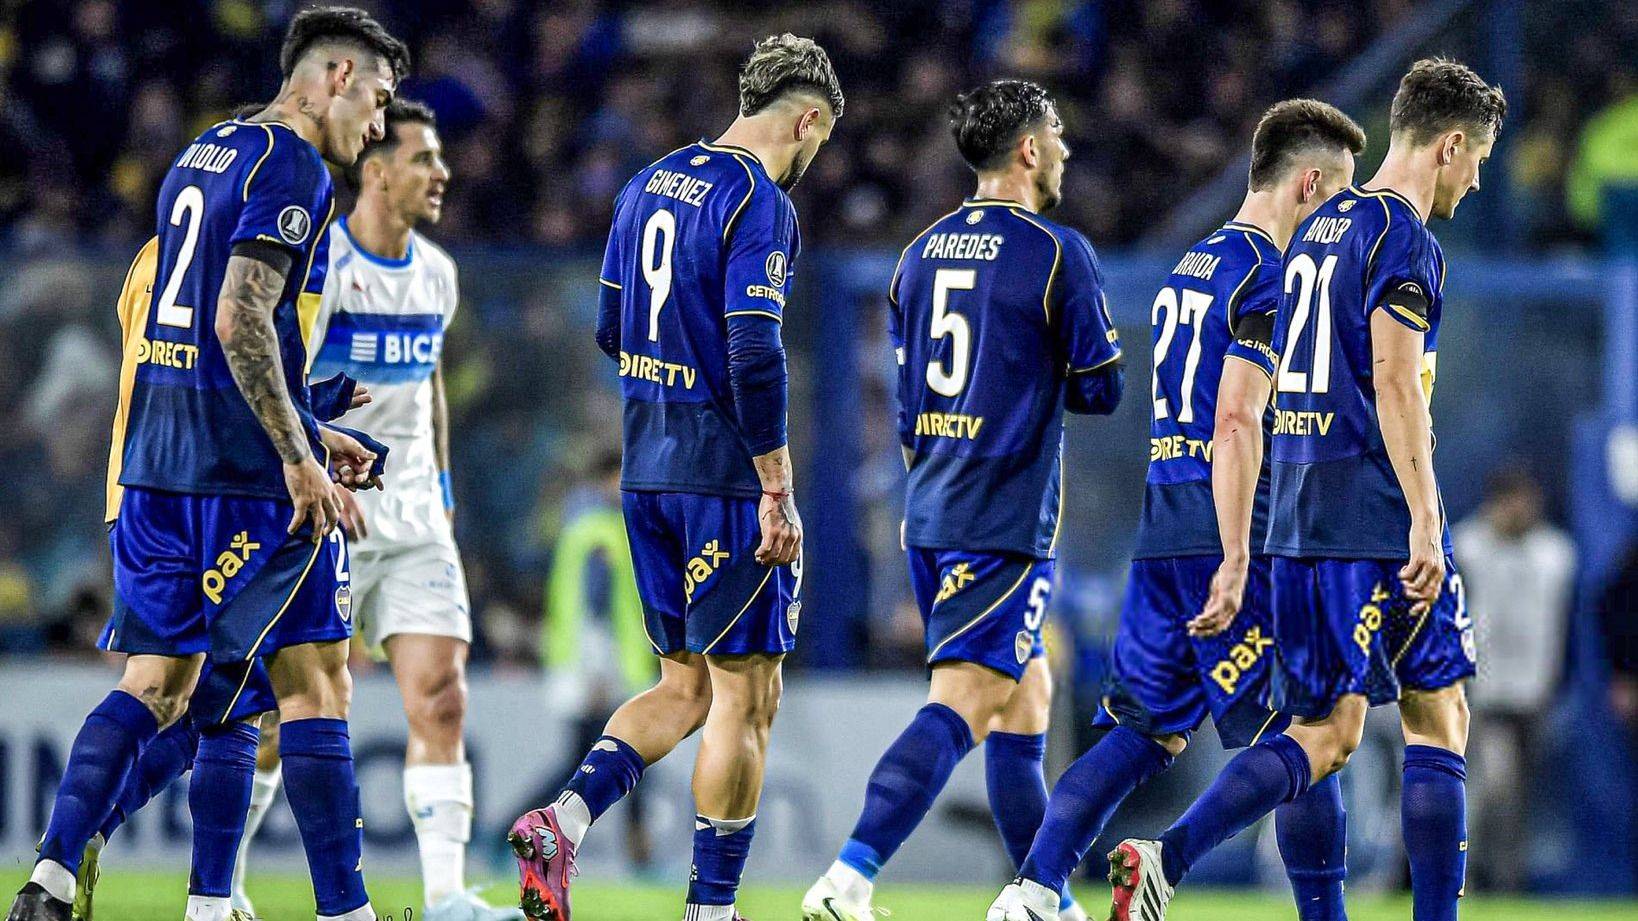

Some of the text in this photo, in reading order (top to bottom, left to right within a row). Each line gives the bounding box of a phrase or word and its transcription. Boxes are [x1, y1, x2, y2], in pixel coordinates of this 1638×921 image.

[644, 169, 713, 208] GIMENEZ
[157, 185, 205, 329] 2
[641, 208, 676, 342] 9
[921, 232, 1004, 261] PAREDES
[926, 268, 976, 398] 5
[1151, 286, 1214, 423] 27
[1277, 253, 1338, 394] 21
[619, 350, 696, 390] DIRETV
[1272, 408, 1334, 437] DIRETV
[202, 530, 260, 605] pax
[329, 525, 350, 582] 2
[935, 562, 976, 602] ax
[1024, 577, 1051, 631] 5
[1210, 624, 1275, 695] pax
